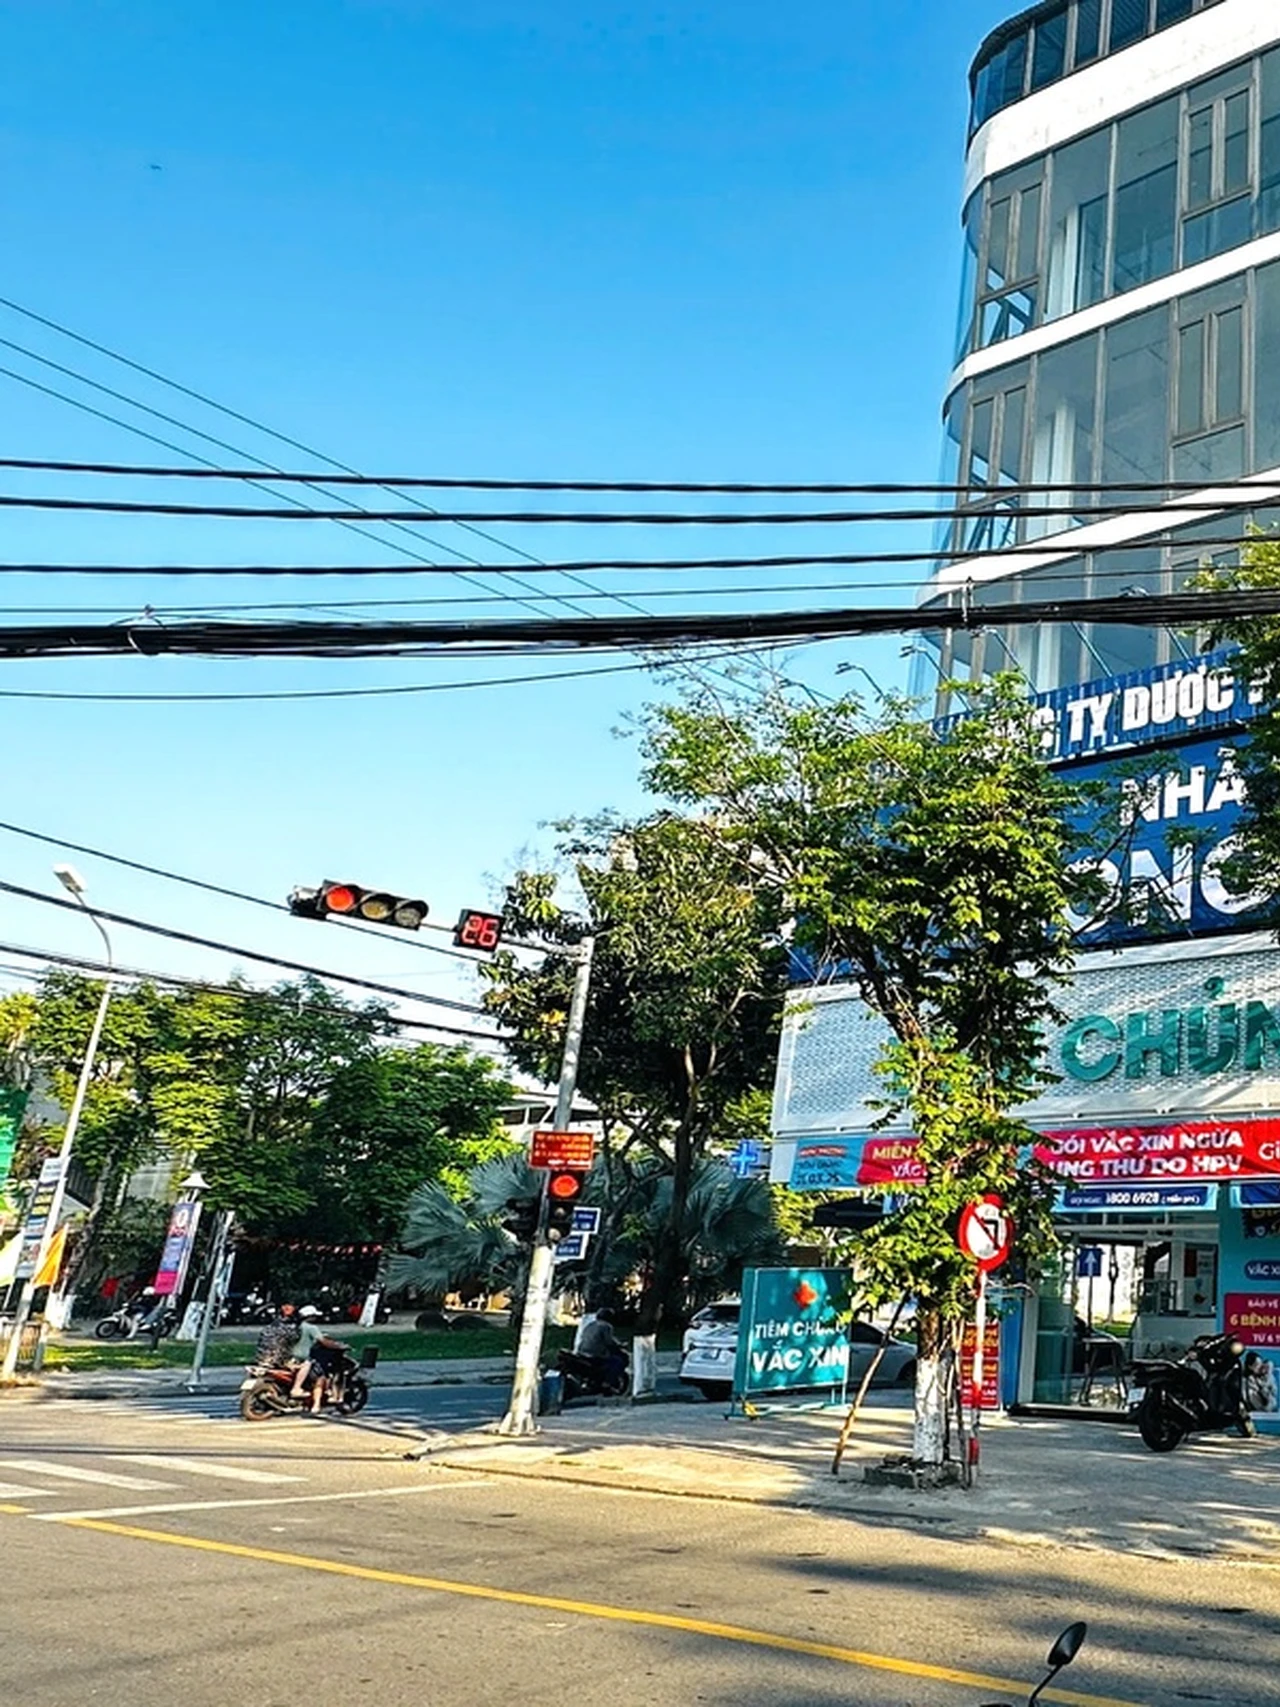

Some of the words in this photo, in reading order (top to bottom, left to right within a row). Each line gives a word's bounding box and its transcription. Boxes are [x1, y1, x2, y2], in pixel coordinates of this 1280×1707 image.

[462, 914, 499, 946] 26
[1138, 1134, 1174, 1151] XIN
[1150, 1158, 1187, 1174] DO
[1192, 1154, 1244, 1172] HPV
[755, 1319, 790, 1339] TIÊM
[1230, 1314, 1239, 1326] 6
[752, 1339, 803, 1373] VẮC
[808, 1345, 850, 1369] XIN
